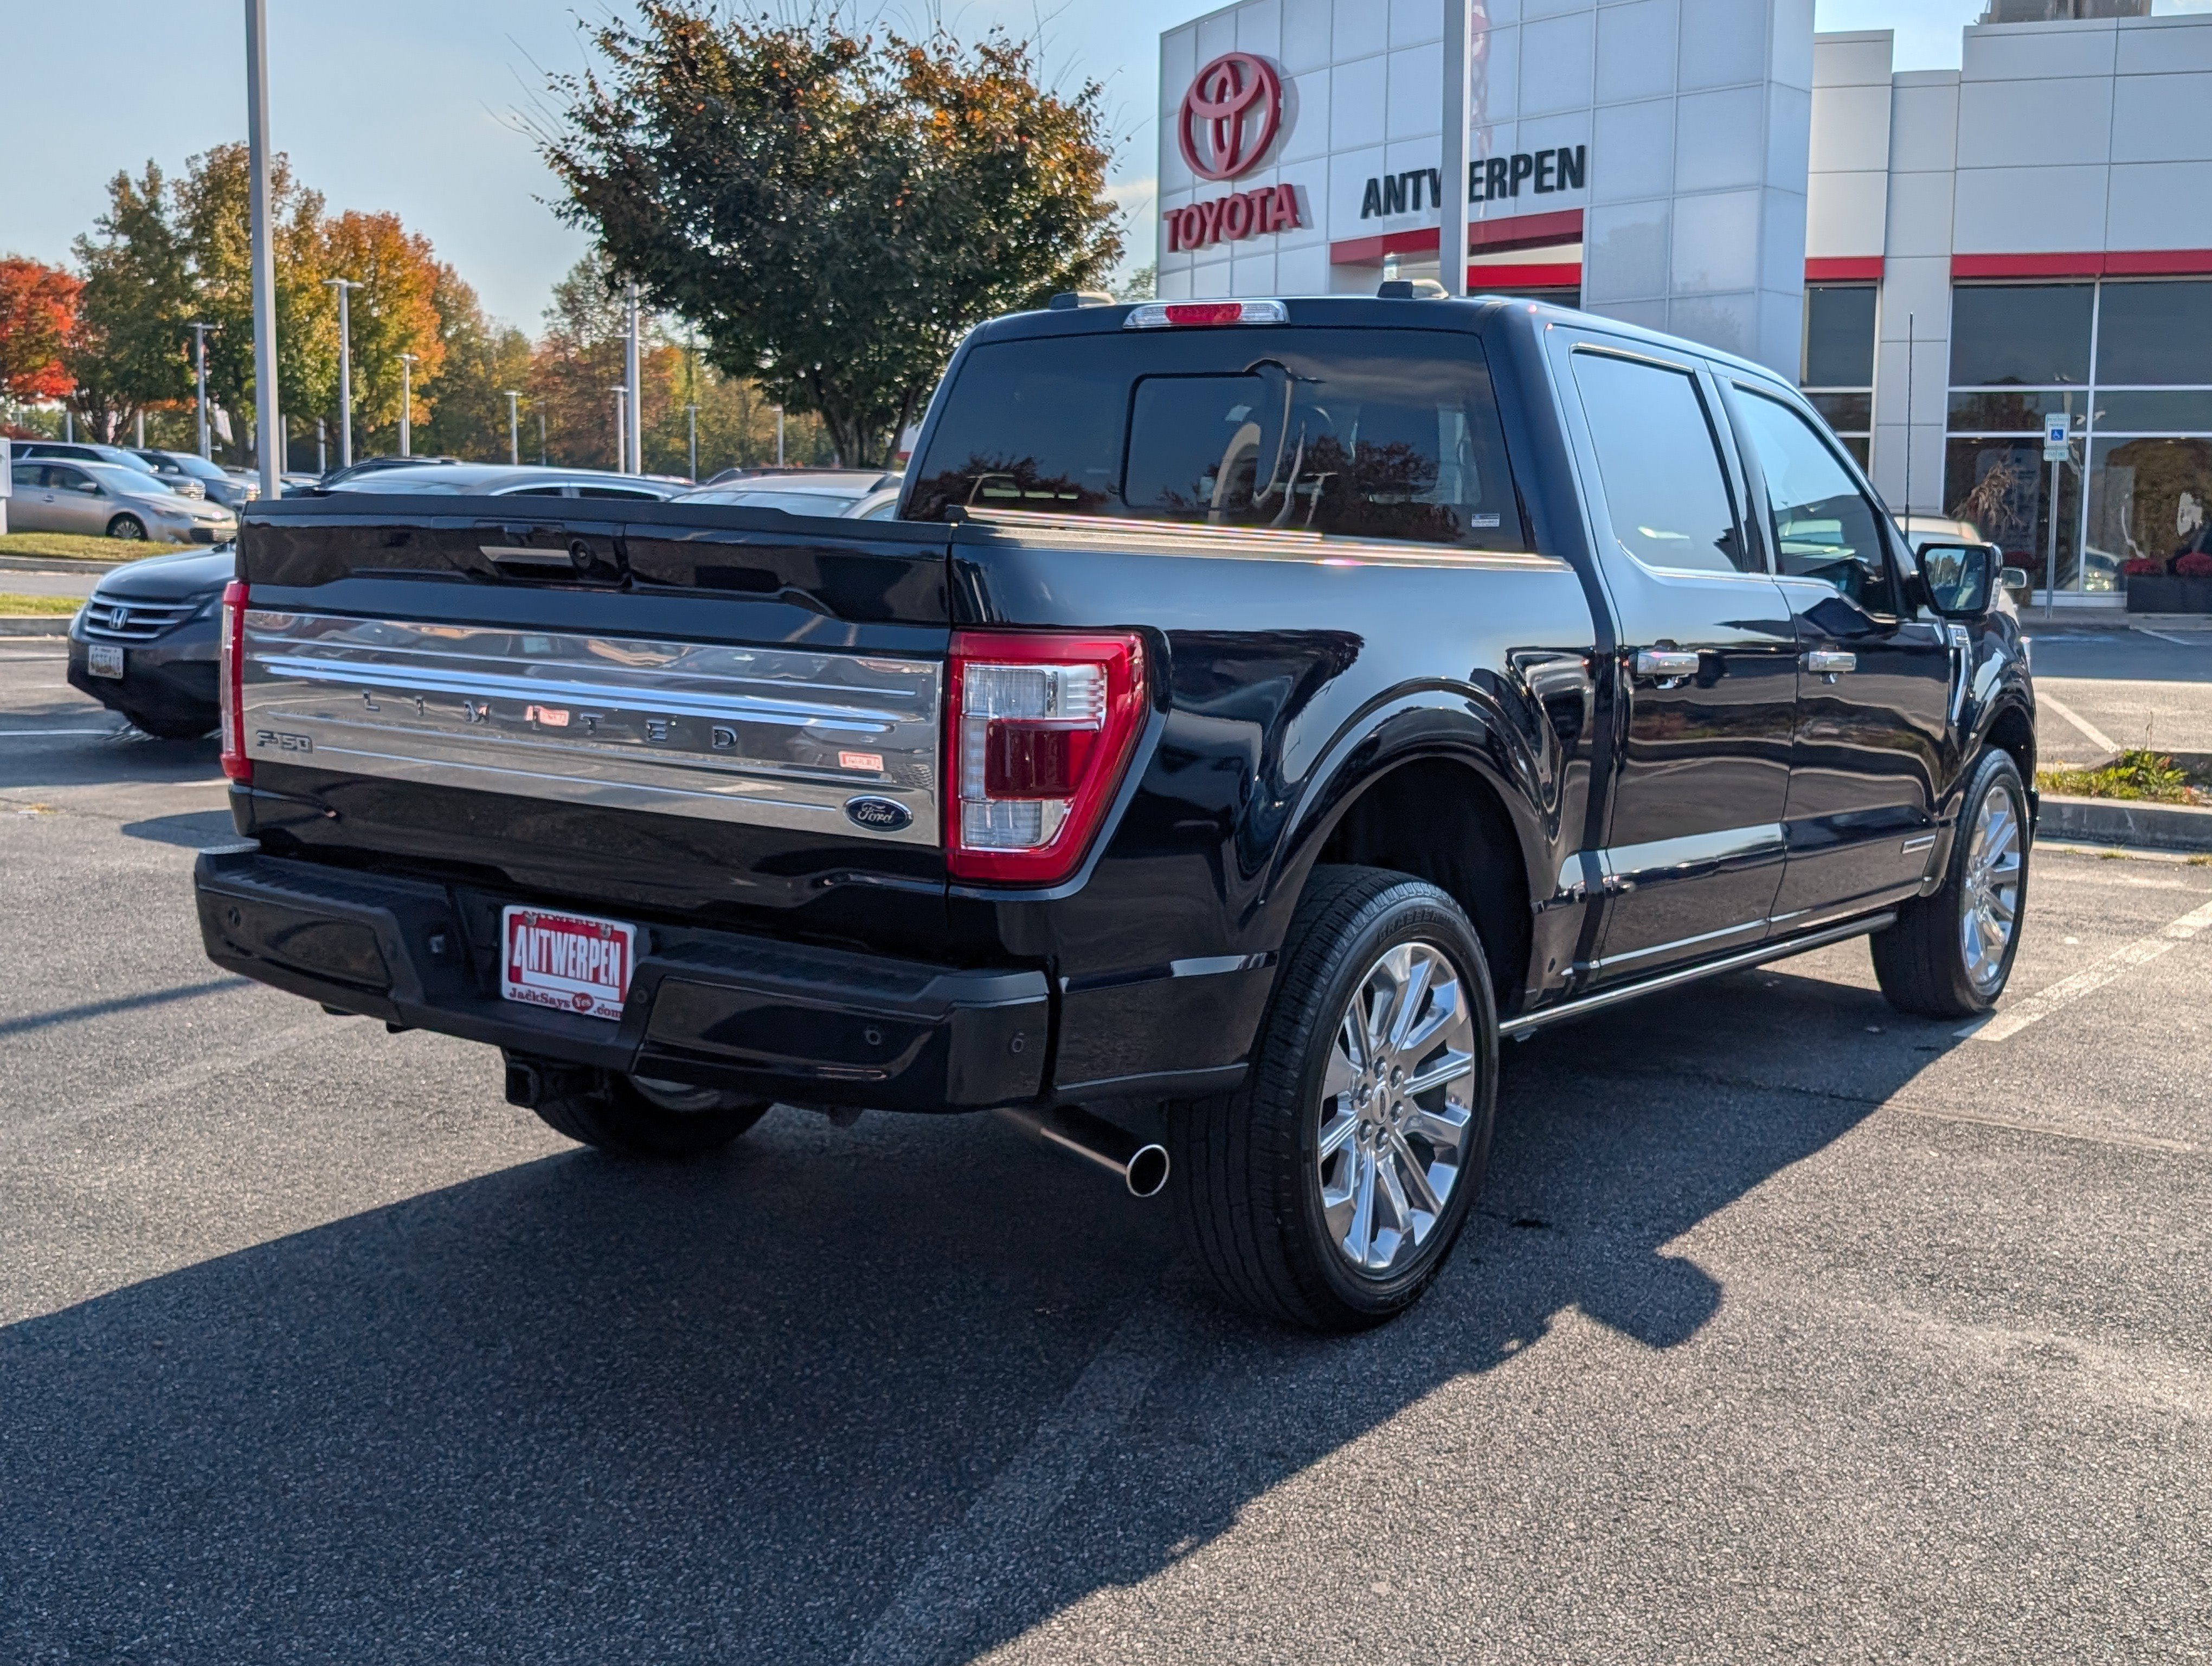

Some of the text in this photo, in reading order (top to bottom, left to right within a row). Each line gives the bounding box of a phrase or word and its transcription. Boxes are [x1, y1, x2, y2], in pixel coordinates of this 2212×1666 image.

[1163, 183, 1301, 253] TOYOTA
[857, 802, 895, 824] Ford
[512, 924, 621, 987] ANTWERPEN
